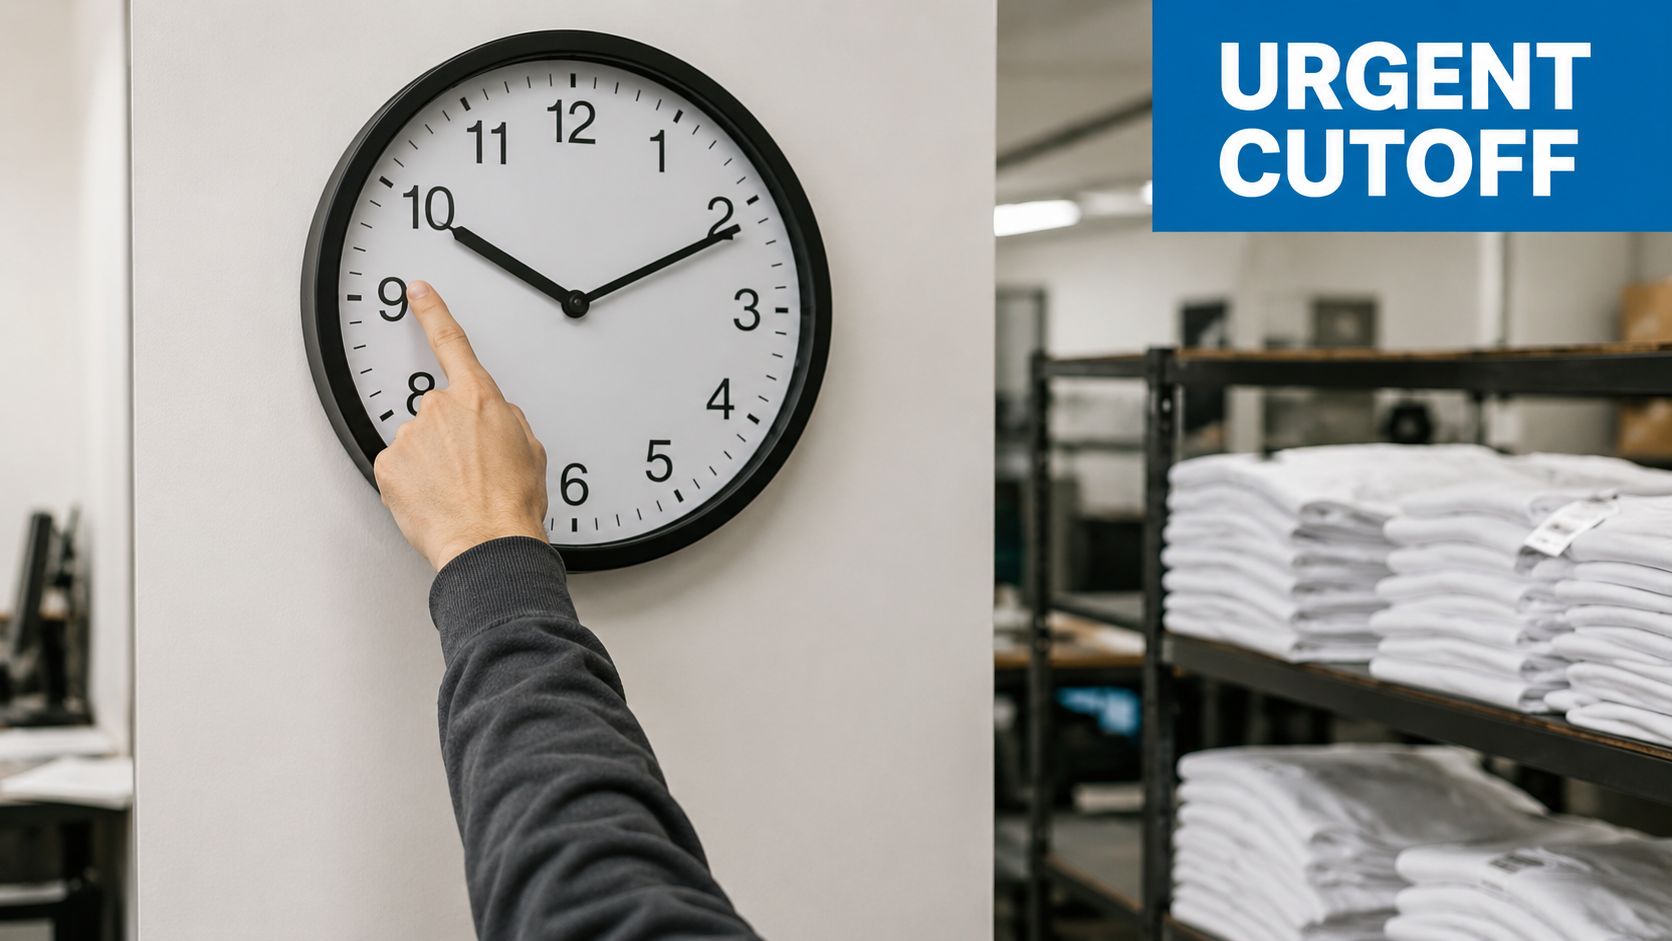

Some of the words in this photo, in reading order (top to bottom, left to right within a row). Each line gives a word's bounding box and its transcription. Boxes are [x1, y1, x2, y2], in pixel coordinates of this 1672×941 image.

[466, 120, 508, 165] 11
[546, 99, 596, 144] 12
[649, 129, 666, 172] 1
[402, 185, 455, 231] 10
[706, 196, 735, 240] 2
[377, 277, 409, 322] 9
[733, 288, 761, 331] 3
[705, 377, 735, 420] 4
[645, 439, 673, 483] 5
[560, 463, 589, 506] 6
